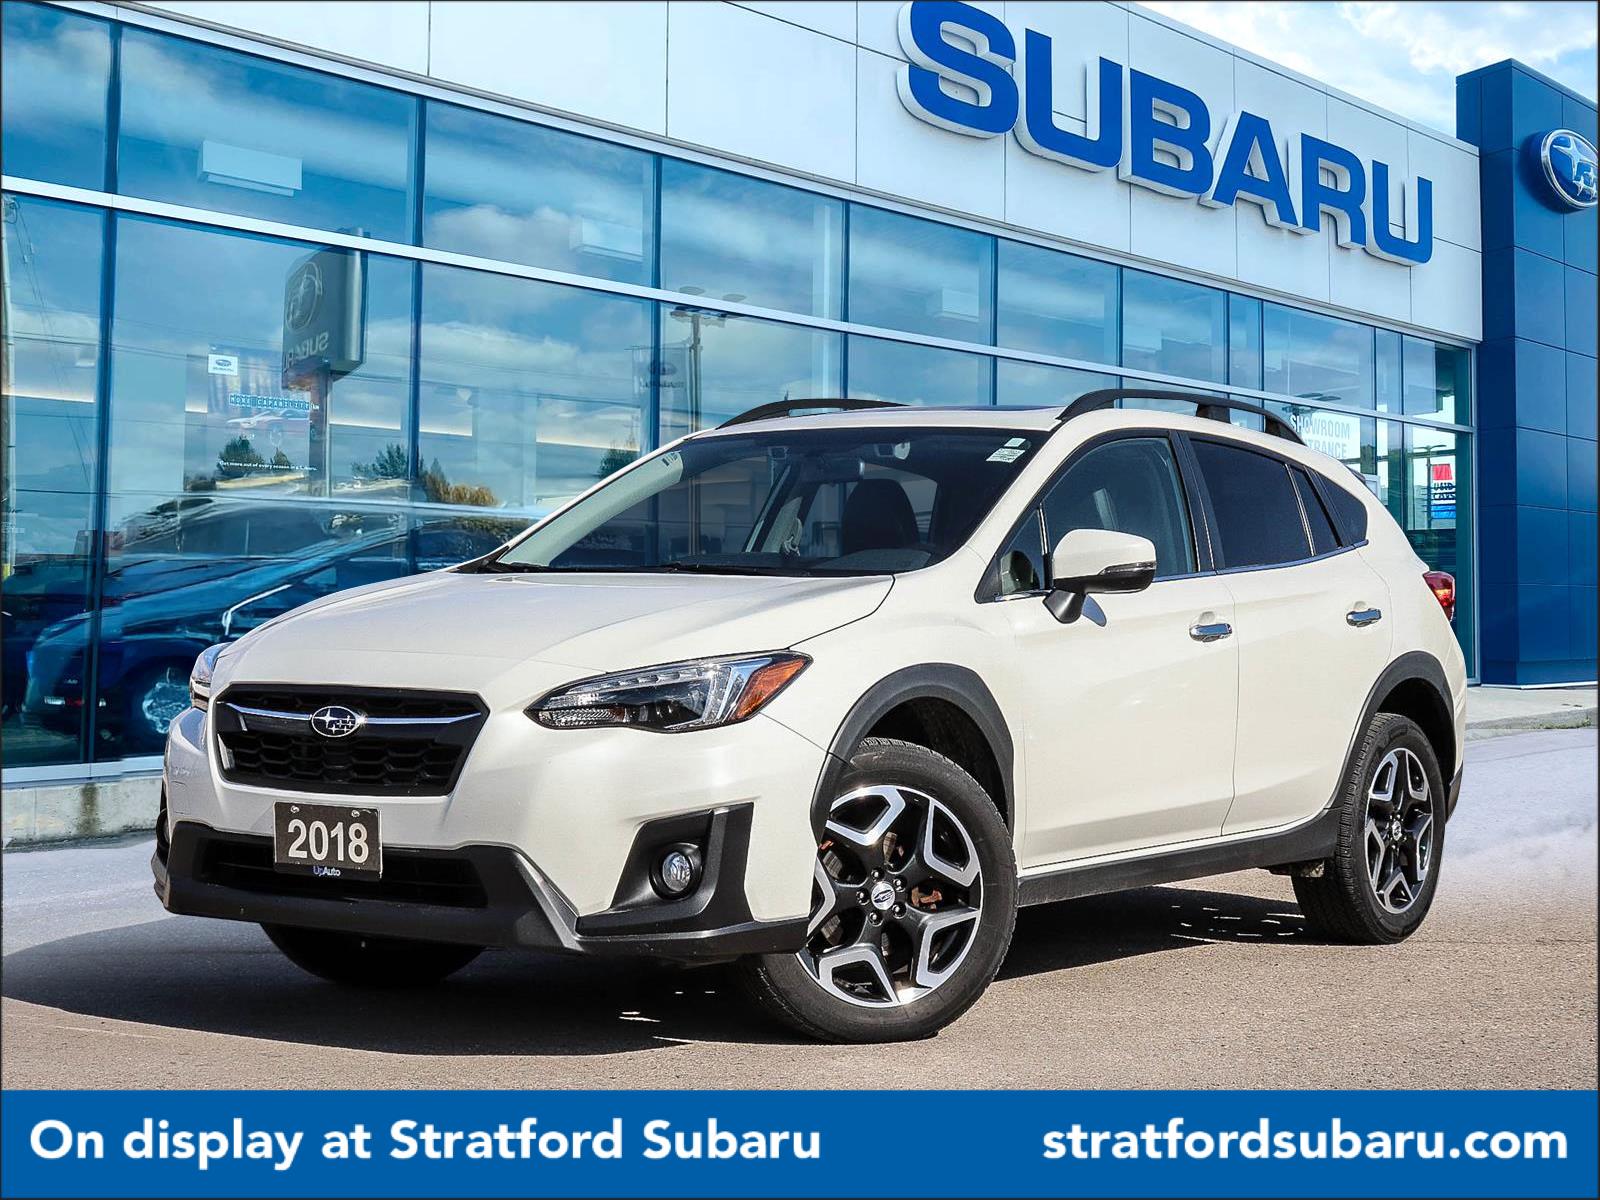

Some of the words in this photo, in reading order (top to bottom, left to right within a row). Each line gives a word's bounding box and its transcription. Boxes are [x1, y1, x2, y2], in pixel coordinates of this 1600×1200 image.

[898, 0, 1433, 265] SUBARU
[1290, 414, 1351, 440] SHOWROOM
[1305, 438, 1347, 460] TRANCE
[287, 818, 369, 864] 2018
[313, 865, 341, 877] UpAuto
